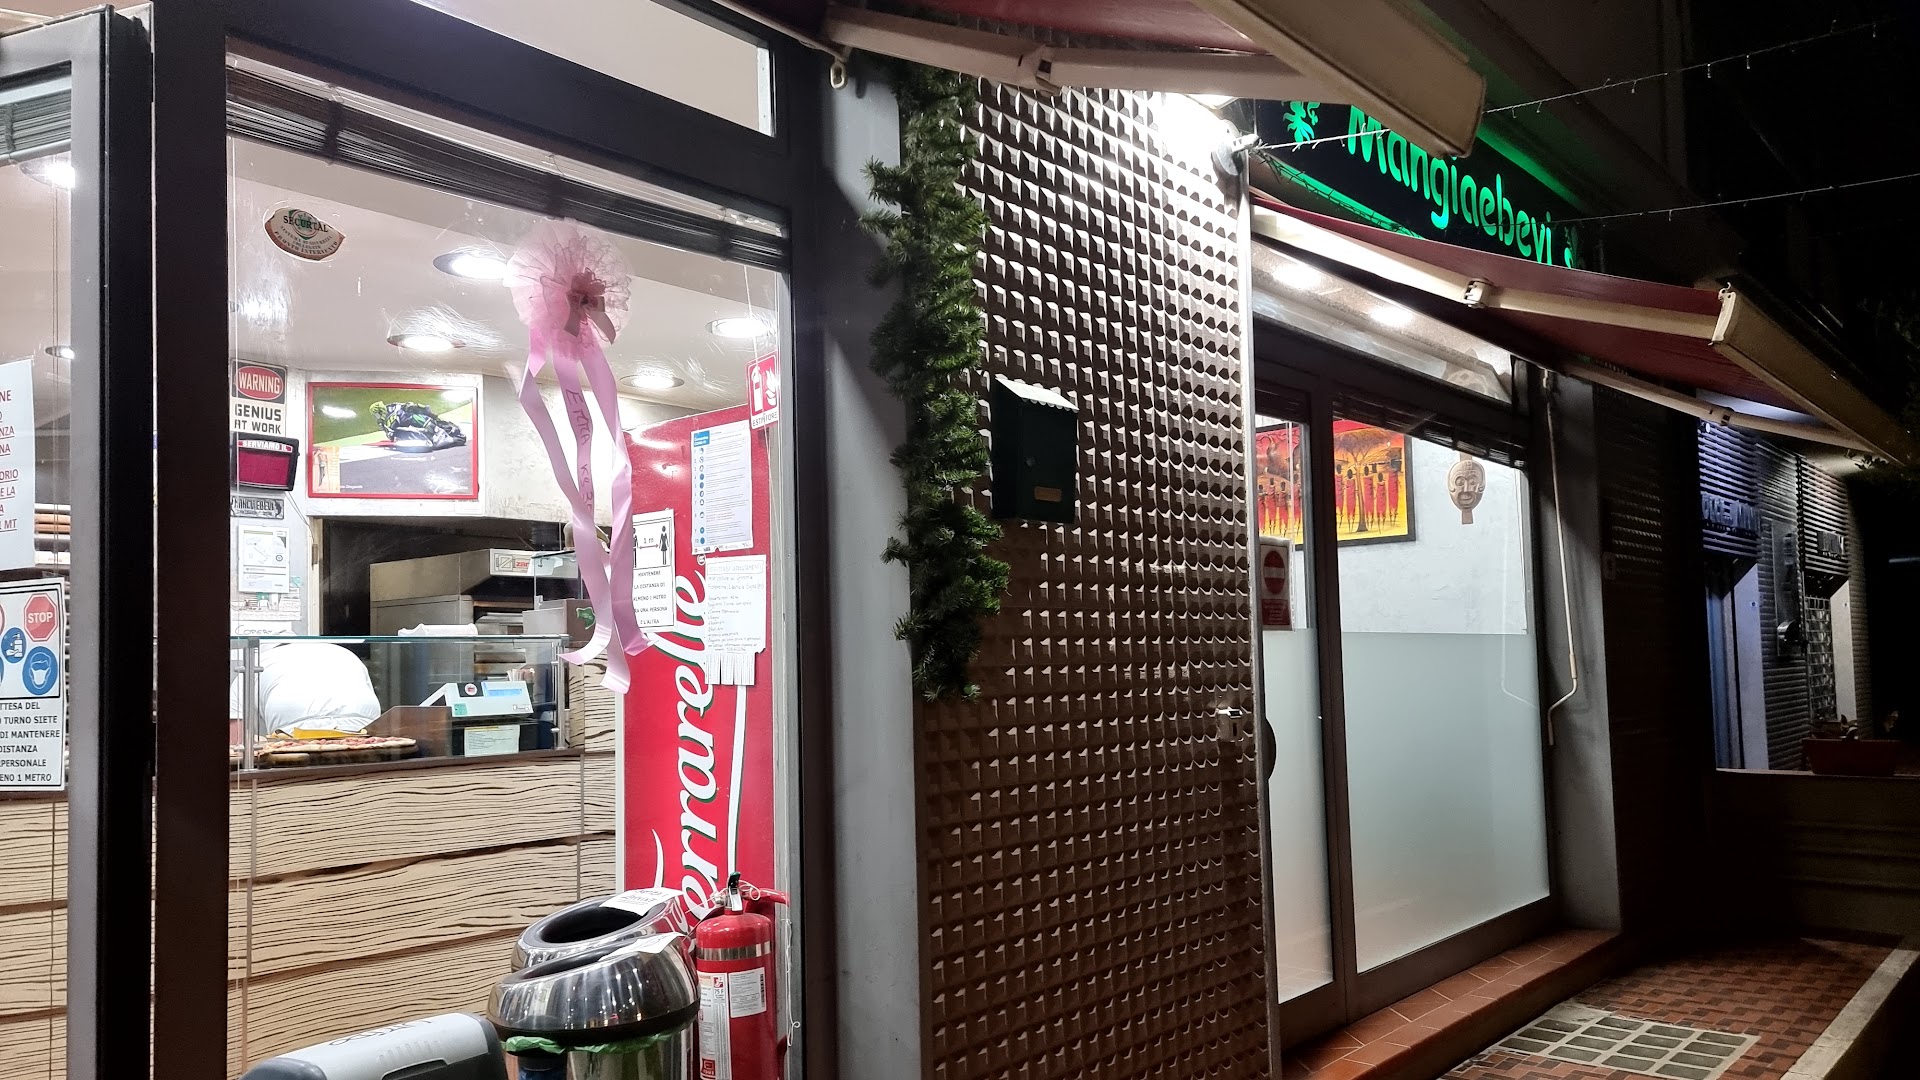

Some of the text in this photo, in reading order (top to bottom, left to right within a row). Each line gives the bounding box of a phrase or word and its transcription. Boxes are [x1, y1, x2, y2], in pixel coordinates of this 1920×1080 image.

[1347, 105, 1552, 266] Mangiaebevi
[238, 371, 281, 395] WARNING
[234, 403, 282, 422] GENIUS
[752, 411, 778, 427] ESTINTORE
[251, 421, 282, 435] WORK
[242, 440, 281, 451] SERVIAMO
[6, 485, 16, 496] LA
[3, 518, 17, 530] MT
[27, 611, 54, 624] STOP
[25, 702, 41, 711] DEL
[4, 715, 58, 725] TURNO SIETE
[10, 729, 61, 739] MANTENERE
[645, 570, 720, 922] errarelle
[25, 773, 52, 782] METRO
